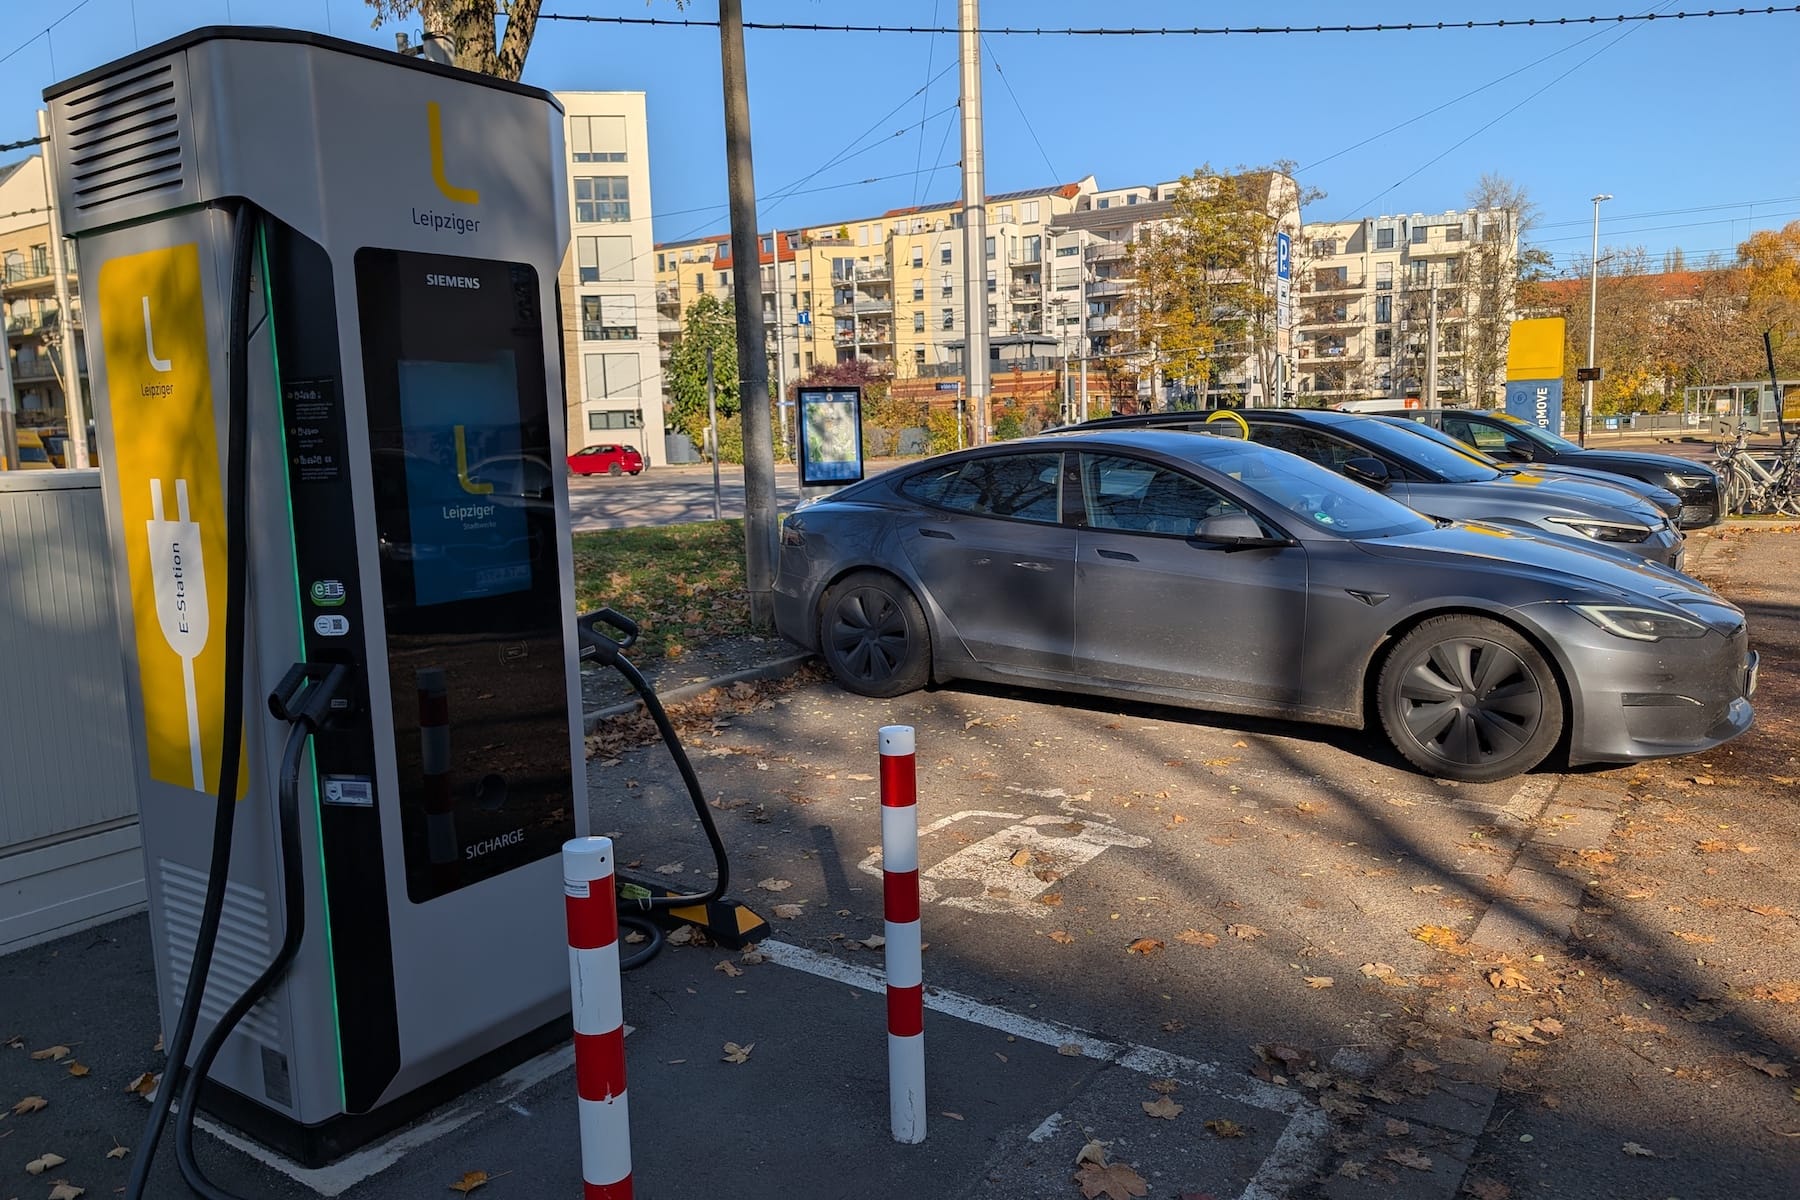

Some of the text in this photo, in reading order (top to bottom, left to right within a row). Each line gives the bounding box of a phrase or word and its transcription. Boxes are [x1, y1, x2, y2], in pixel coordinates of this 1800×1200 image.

[411, 207, 481, 235] Leipziger
[1280, 239, 1288, 272] P
[425, 272, 481, 290] SIEMENS
[140, 383, 174, 399] Leipziger
[443, 504, 496, 520] Leipziger
[172, 542, 189, 633] E-Station
[465, 828, 525, 860] SICHARGE
